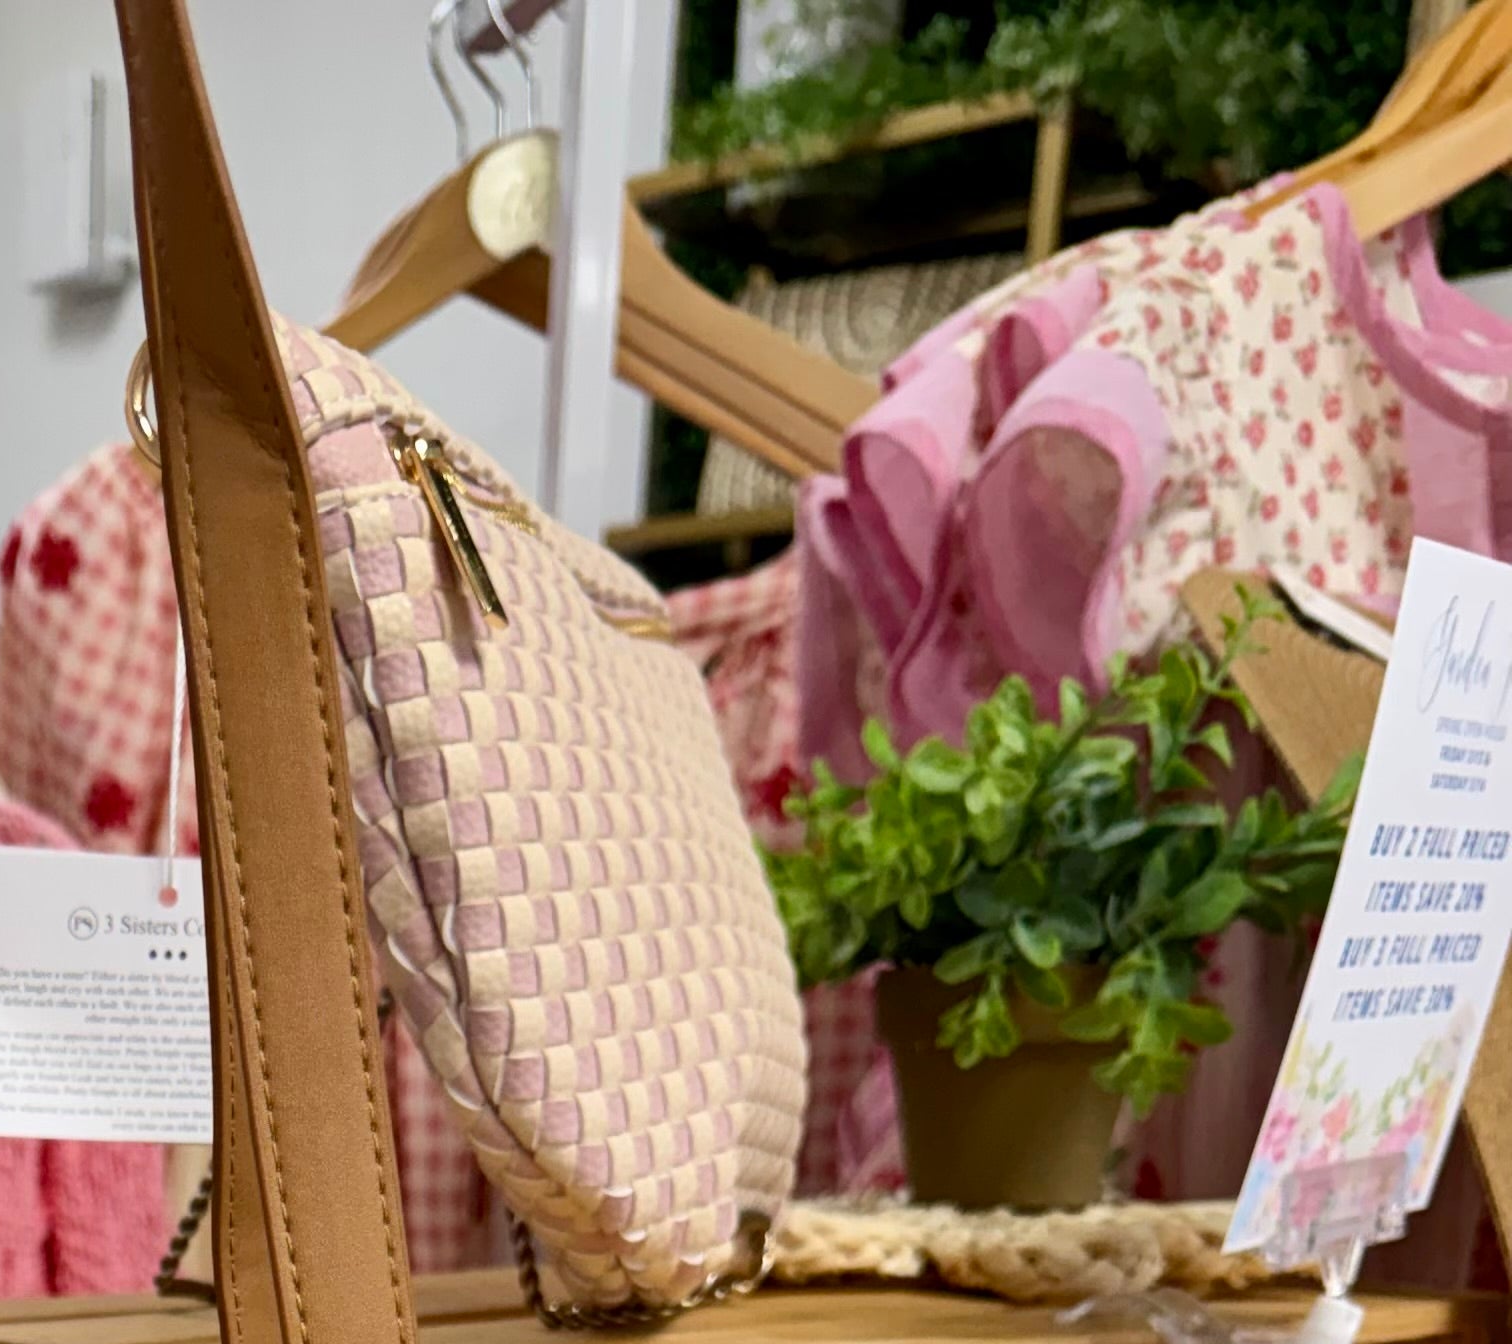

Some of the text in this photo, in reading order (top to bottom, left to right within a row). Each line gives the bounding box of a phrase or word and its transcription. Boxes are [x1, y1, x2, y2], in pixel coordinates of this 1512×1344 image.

[1370, 823, 1510, 860] BUY 2 FULL PRICED
[1365, 880, 1486, 913] ITEMS SAVE 20%
[103, 914, 113, 935] 3
[120, 915, 178, 937] Sisters
[1338, 933, 1482, 968] BUY 3 FULL PRICED
[1332, 988, 1386, 1021] ITEMS
[1383, 985, 1426, 1017] SAVE
